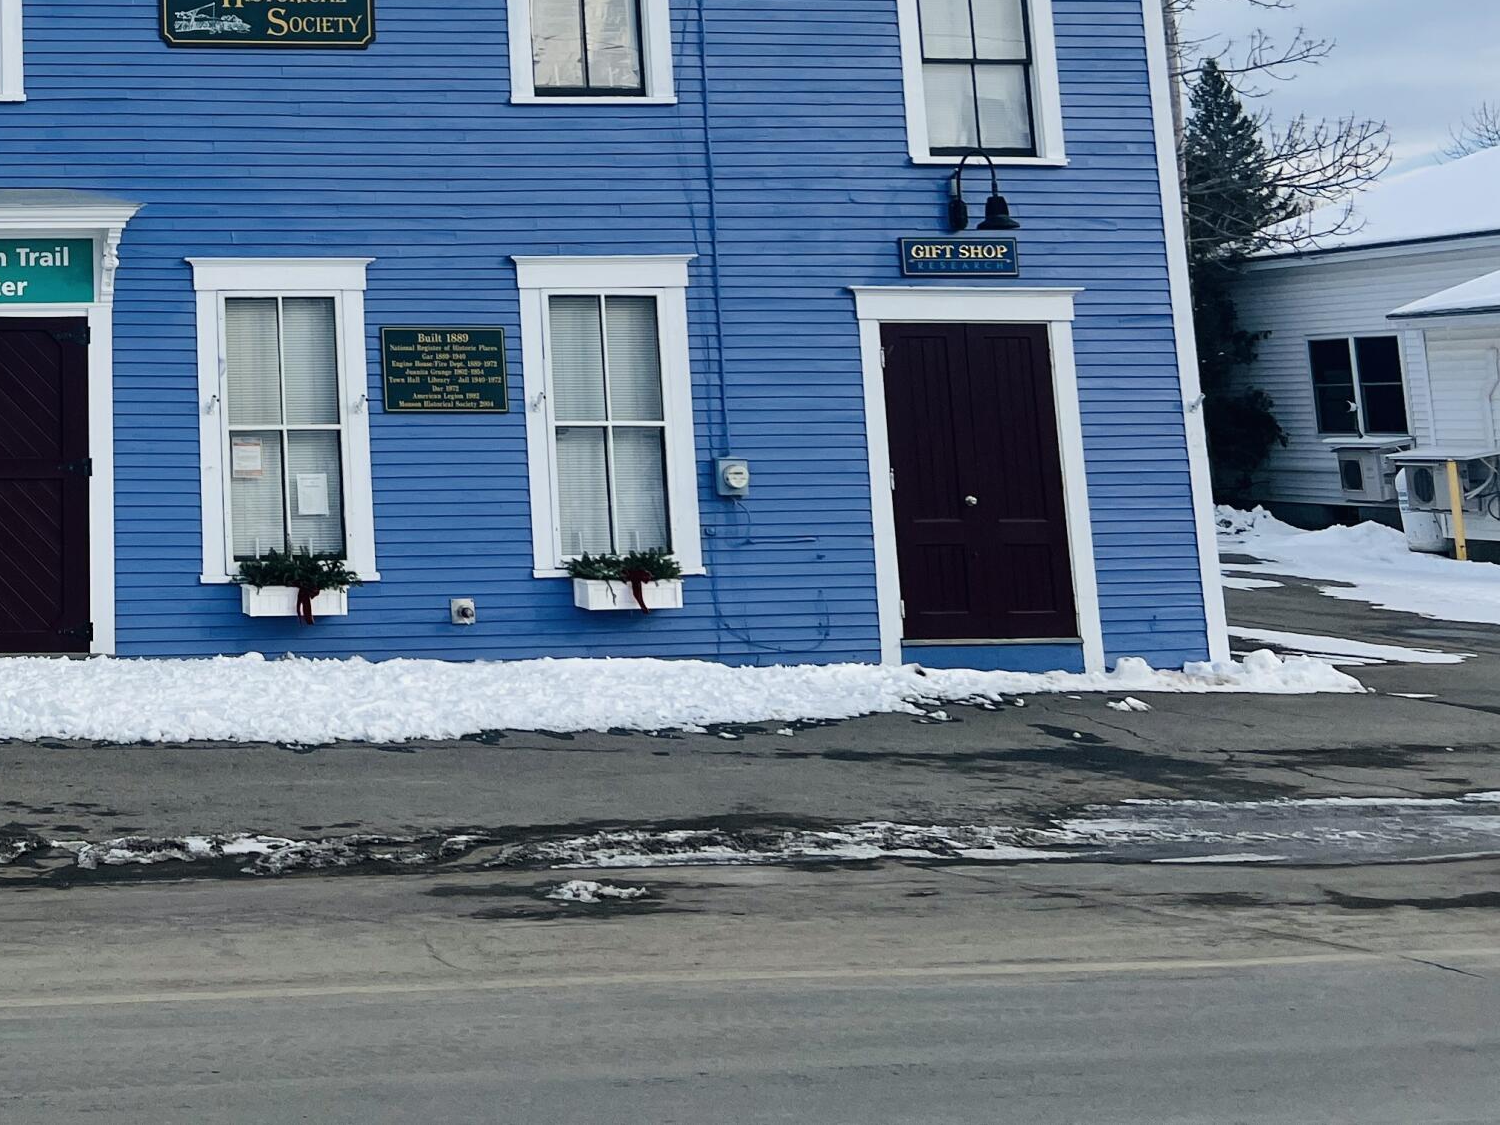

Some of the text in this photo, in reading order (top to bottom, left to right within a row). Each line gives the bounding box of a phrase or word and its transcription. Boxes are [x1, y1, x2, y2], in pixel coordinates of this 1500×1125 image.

[911, 244, 1008, 258] GIFT SHOP
[16, 247, 69, 267] Trail
[917, 261, 1004, 270] RESEARCH
[418, 333, 469, 343] Built 1889
[417, 344, 442, 352] Register
[427, 376, 450, 384] Library
[455, 400, 477, 408] Society
